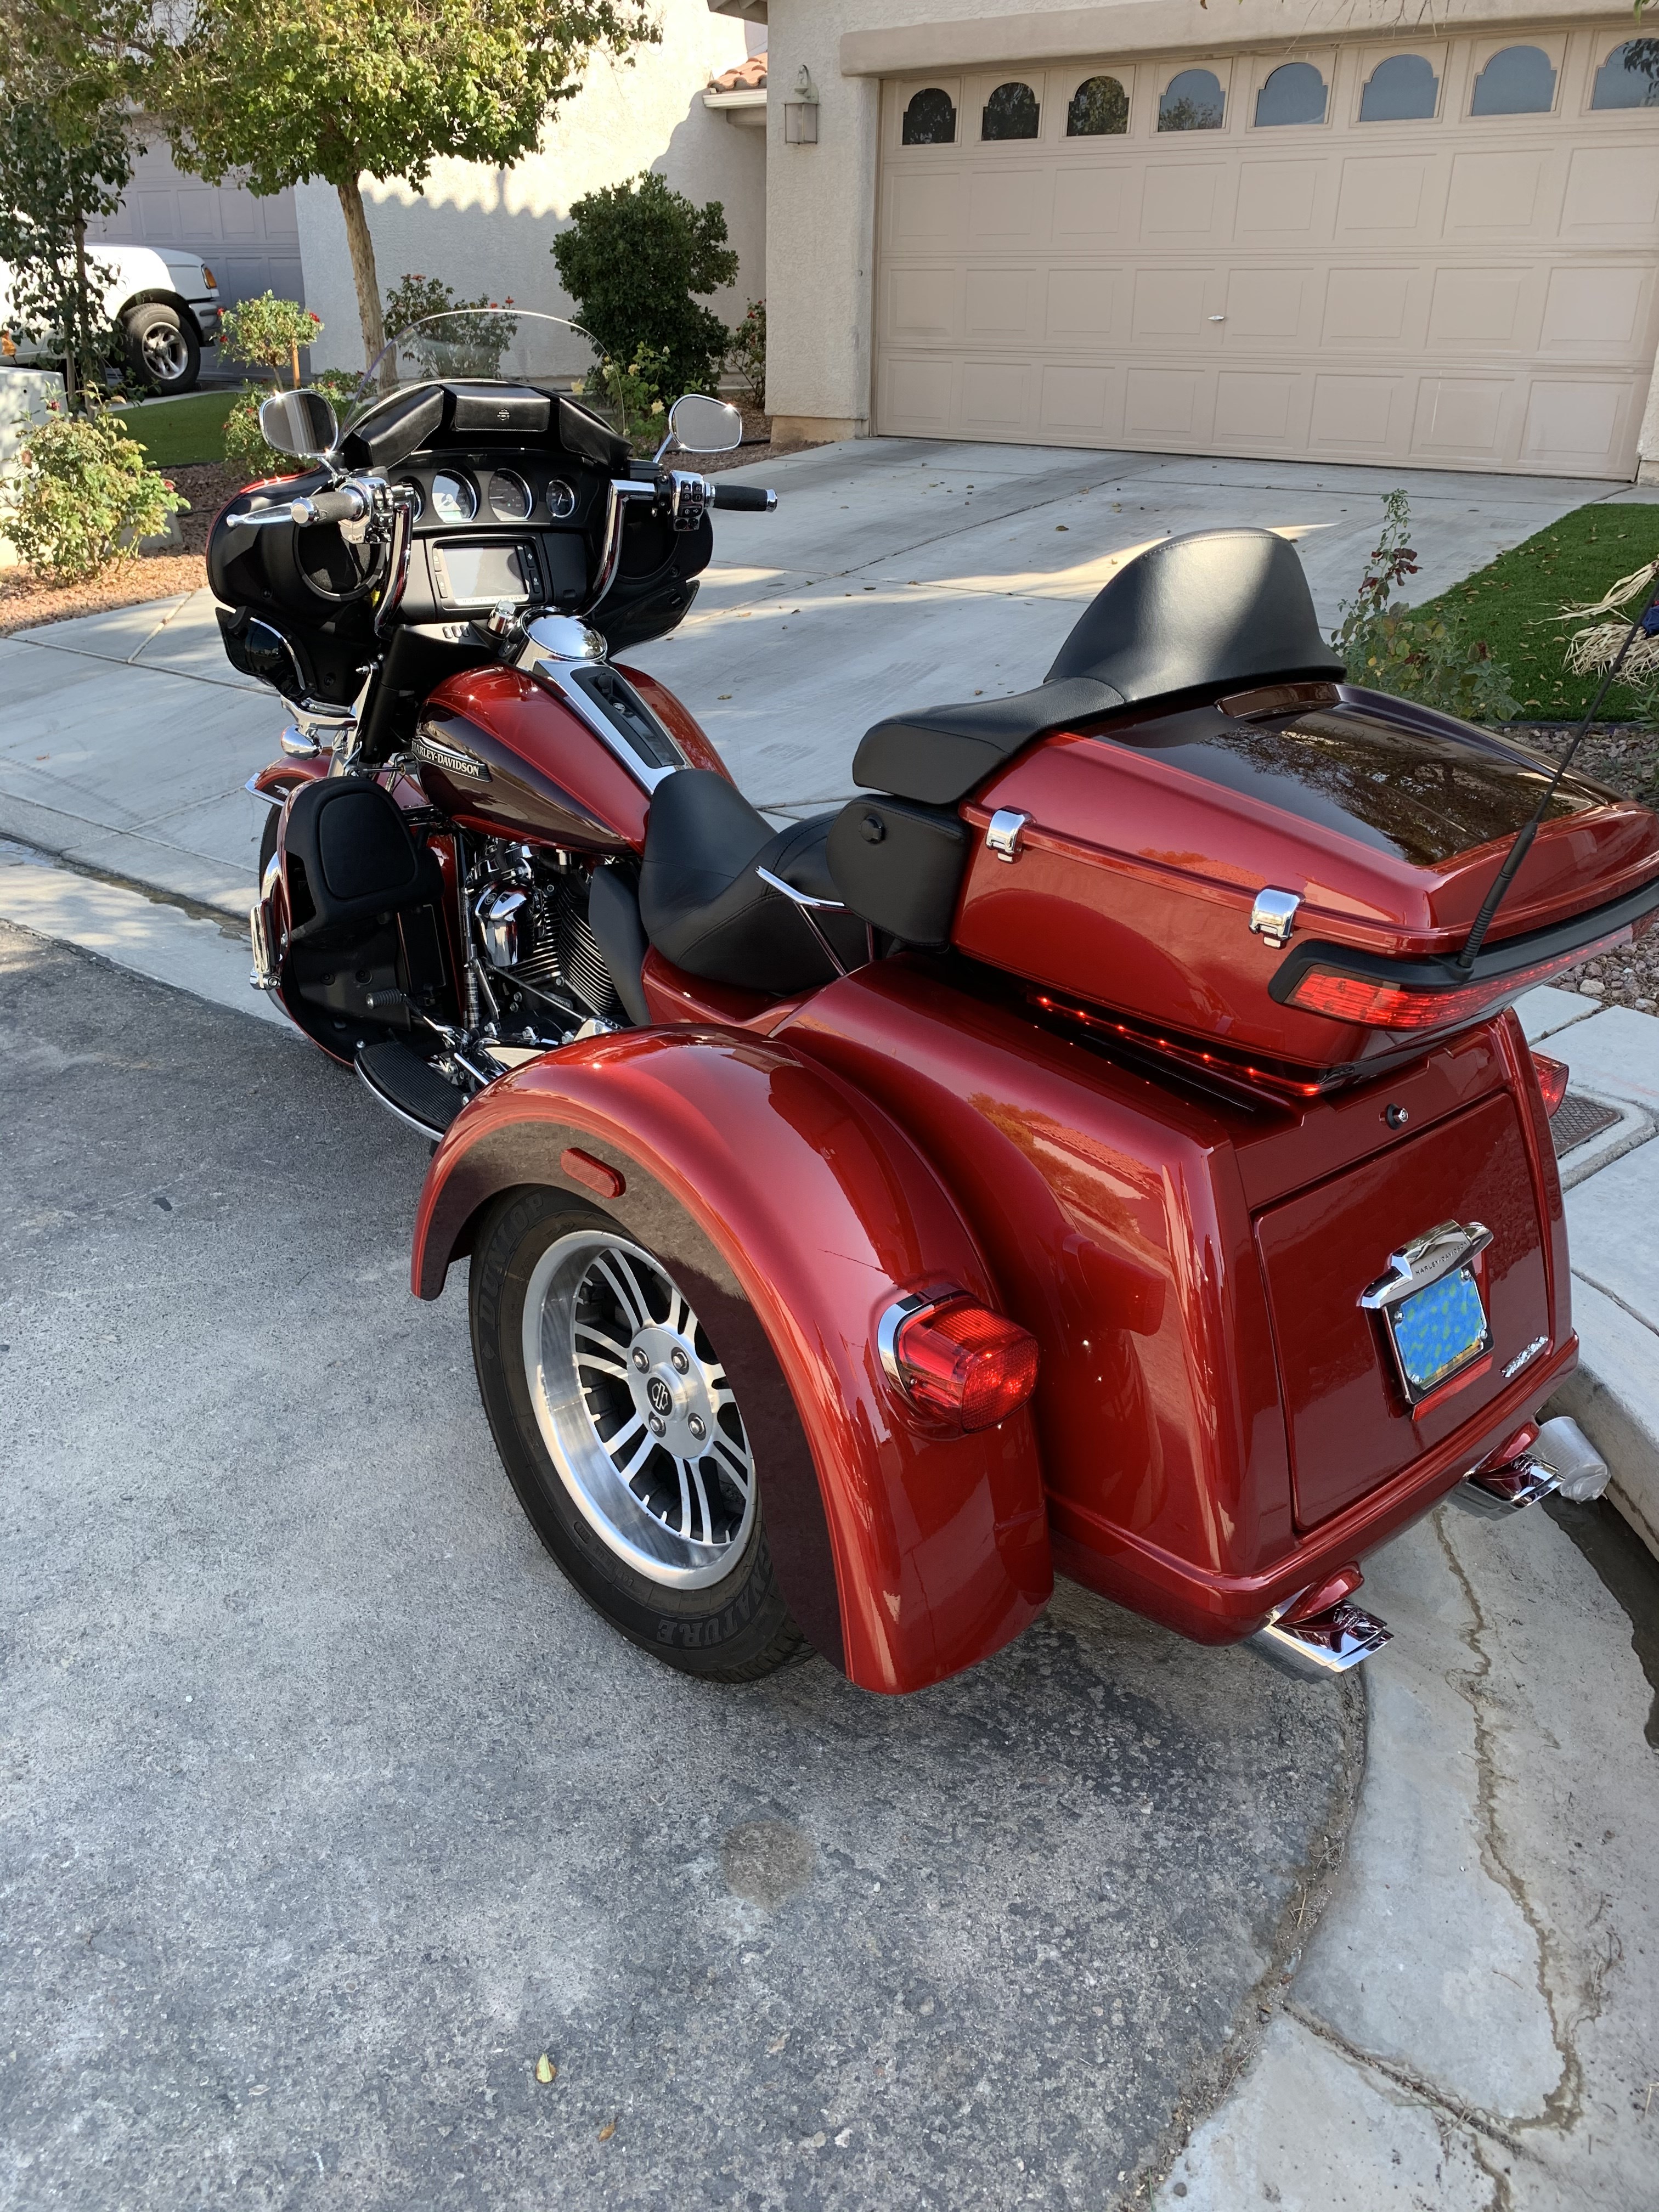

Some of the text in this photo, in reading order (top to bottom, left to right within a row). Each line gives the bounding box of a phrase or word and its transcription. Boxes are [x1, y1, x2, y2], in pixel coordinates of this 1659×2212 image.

[411, 741, 479, 776] HARLEY-DAVIDSON
[479, 1192, 544, 1330] DUNLOP
[1415, 1240, 1469, 1276] HARLEY-DAVIDSON
